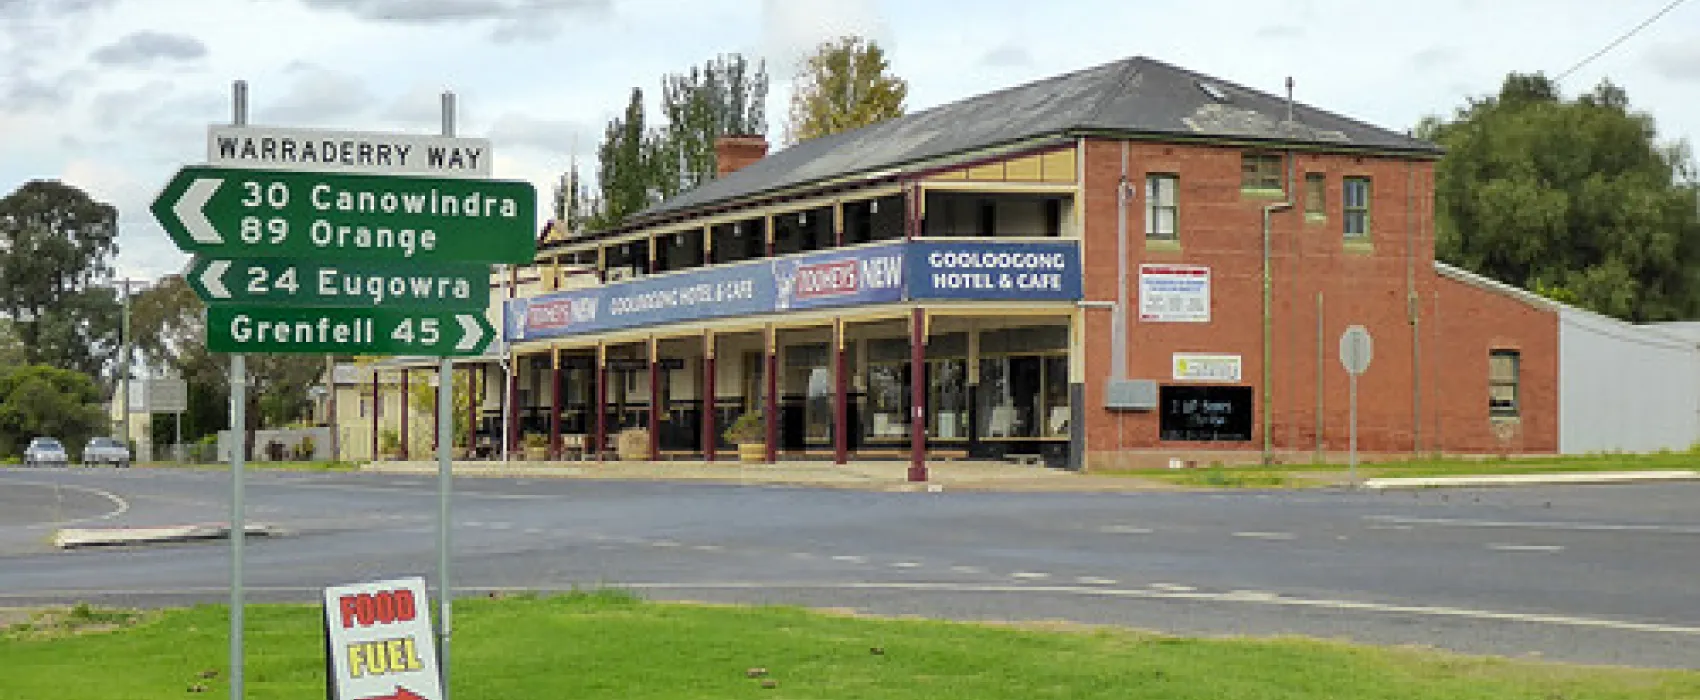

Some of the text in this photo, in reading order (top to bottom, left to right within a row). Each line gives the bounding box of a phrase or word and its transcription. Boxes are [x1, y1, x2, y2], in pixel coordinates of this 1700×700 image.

[217, 137, 482, 169] WARRADERRY WAY
[240, 182, 518, 217] 30 Canowindra
[240, 216, 437, 257] 89 Orange
[861, 256, 902, 288] NEW
[928, 252, 1065, 268] GOOLOOGONG
[247, 266, 470, 304] 24 Eugowra
[933, 273, 1062, 290] HOTEL & CAFE
[230, 315, 440, 345] Grenfell 45
[340, 590, 416, 629] FOOD
[347, 638, 425, 679] FUEL
